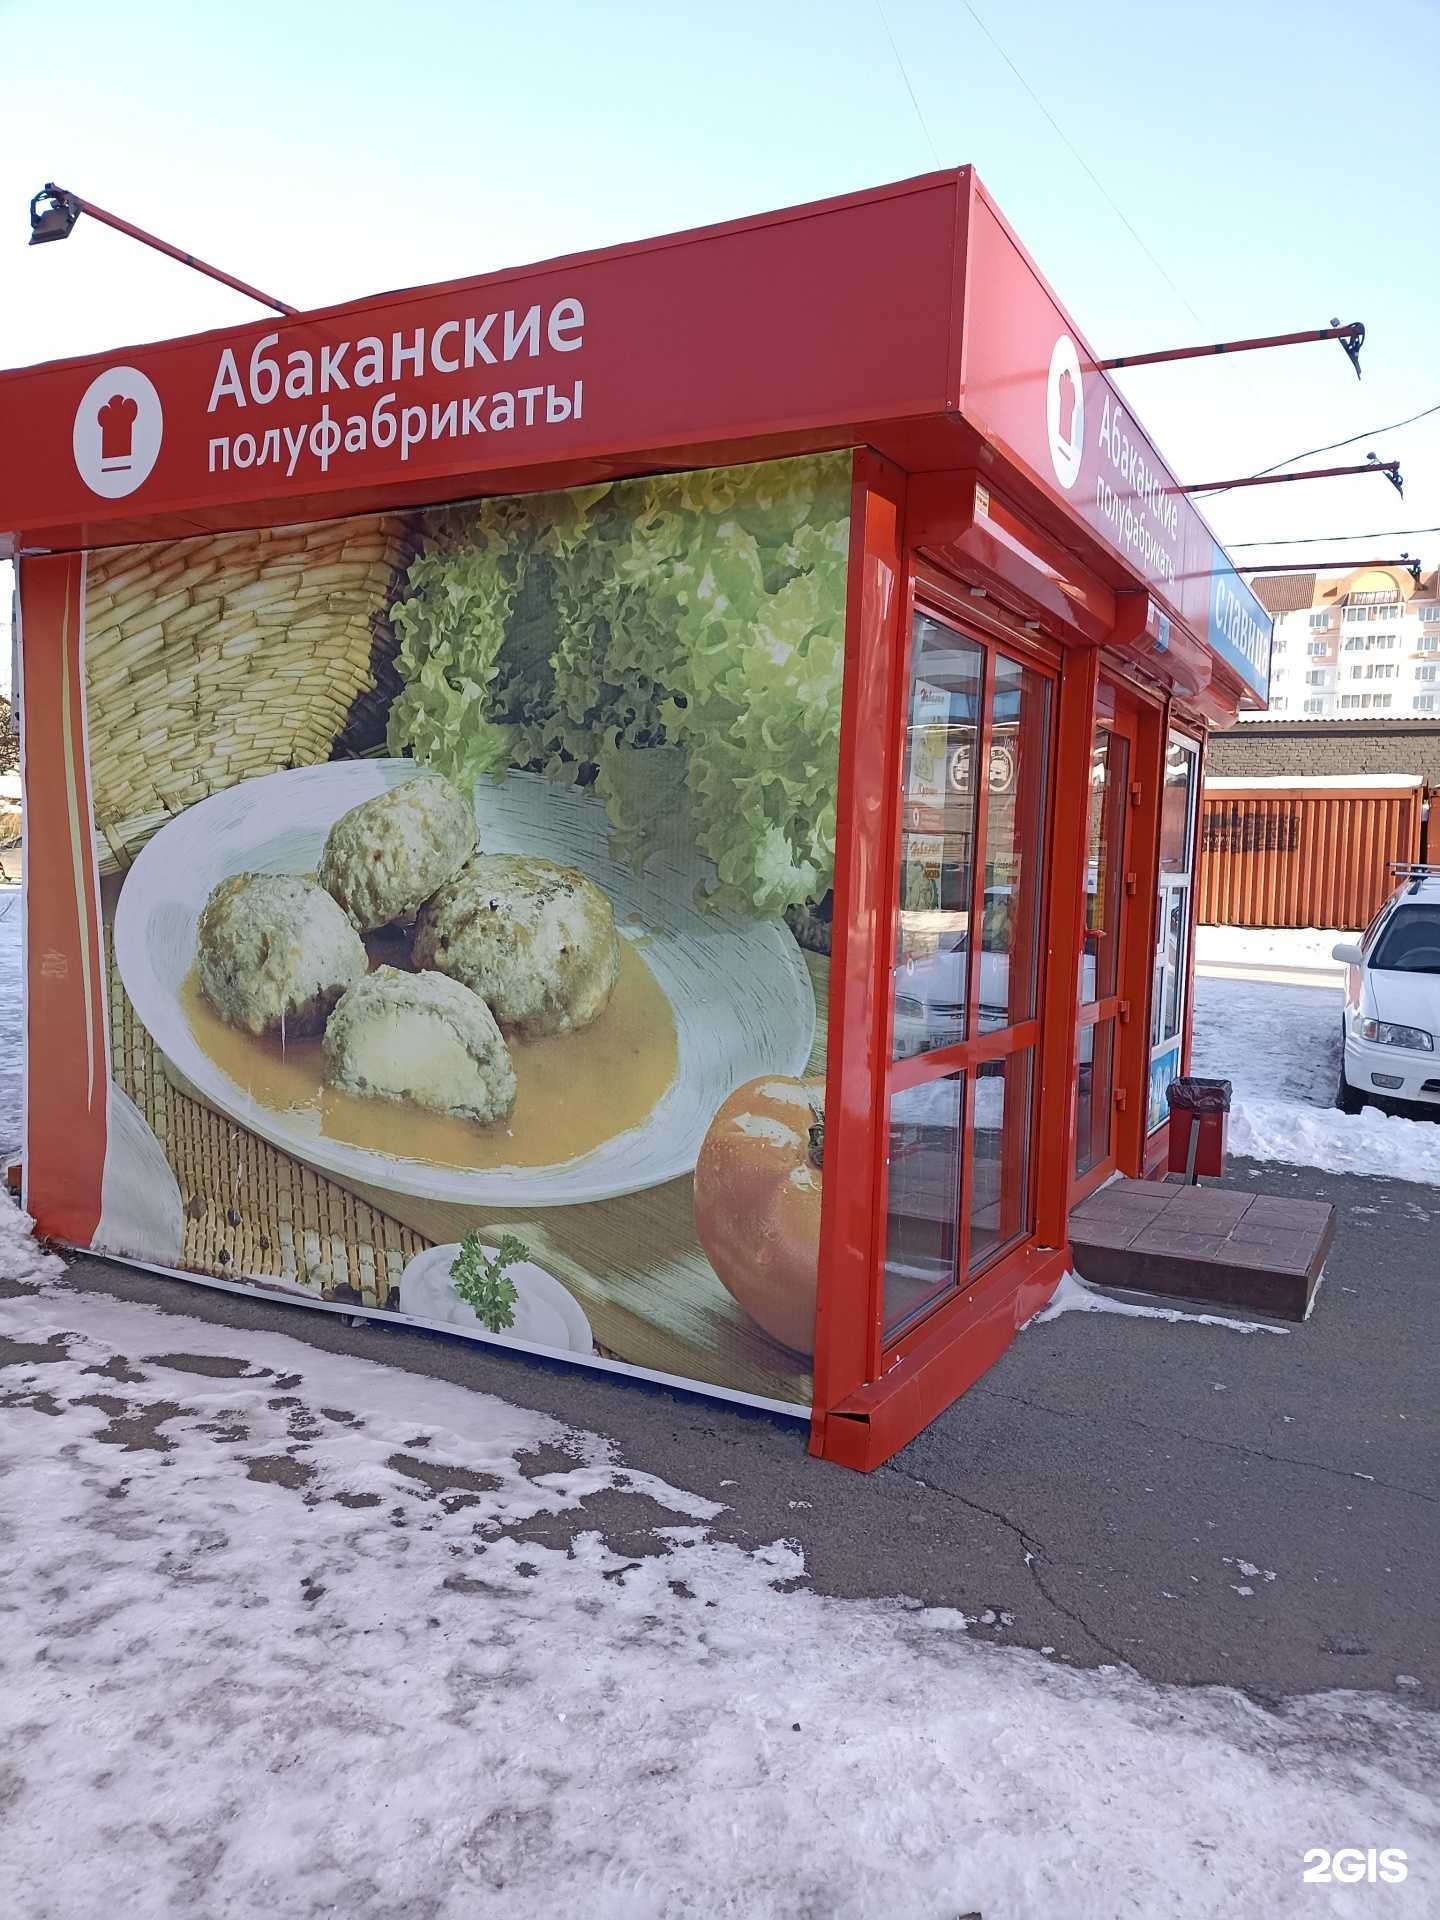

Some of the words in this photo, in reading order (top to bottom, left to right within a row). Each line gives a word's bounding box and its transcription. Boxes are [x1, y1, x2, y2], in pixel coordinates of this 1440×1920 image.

[207, 297, 585, 412] Абаканские
[208, 381, 584, 477] полуфабрикаты
[1099, 395, 1178, 541] Абаканские
[1096, 475, 1177, 585] полуфабрикаты
